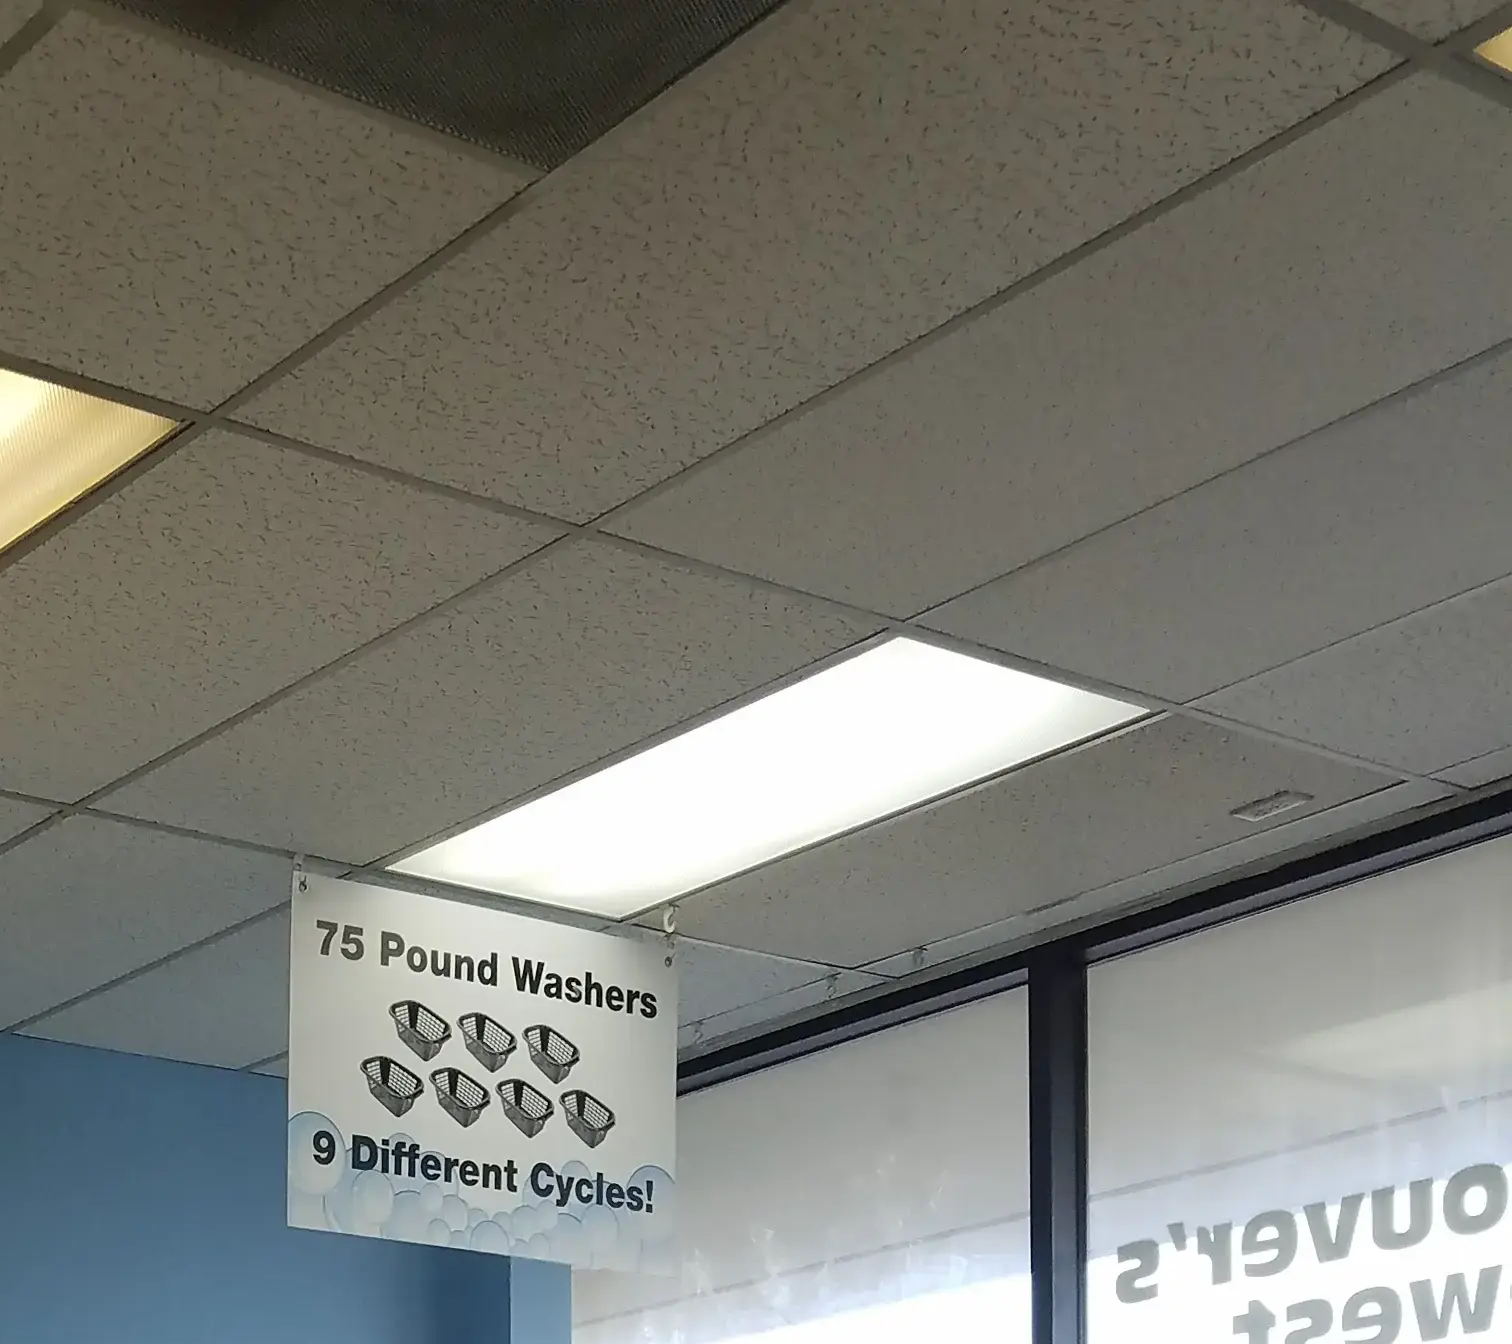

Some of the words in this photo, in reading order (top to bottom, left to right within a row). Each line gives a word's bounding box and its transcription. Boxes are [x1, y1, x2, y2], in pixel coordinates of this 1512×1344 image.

[315, 920, 365, 961] 75
[380, 930, 498, 986] Pound
[511, 956, 658, 1019] Washers
[312, 1130, 336, 1166] 9
[350, 1133, 519, 1193] Different
[529, 1161, 655, 1214] Cycles!
